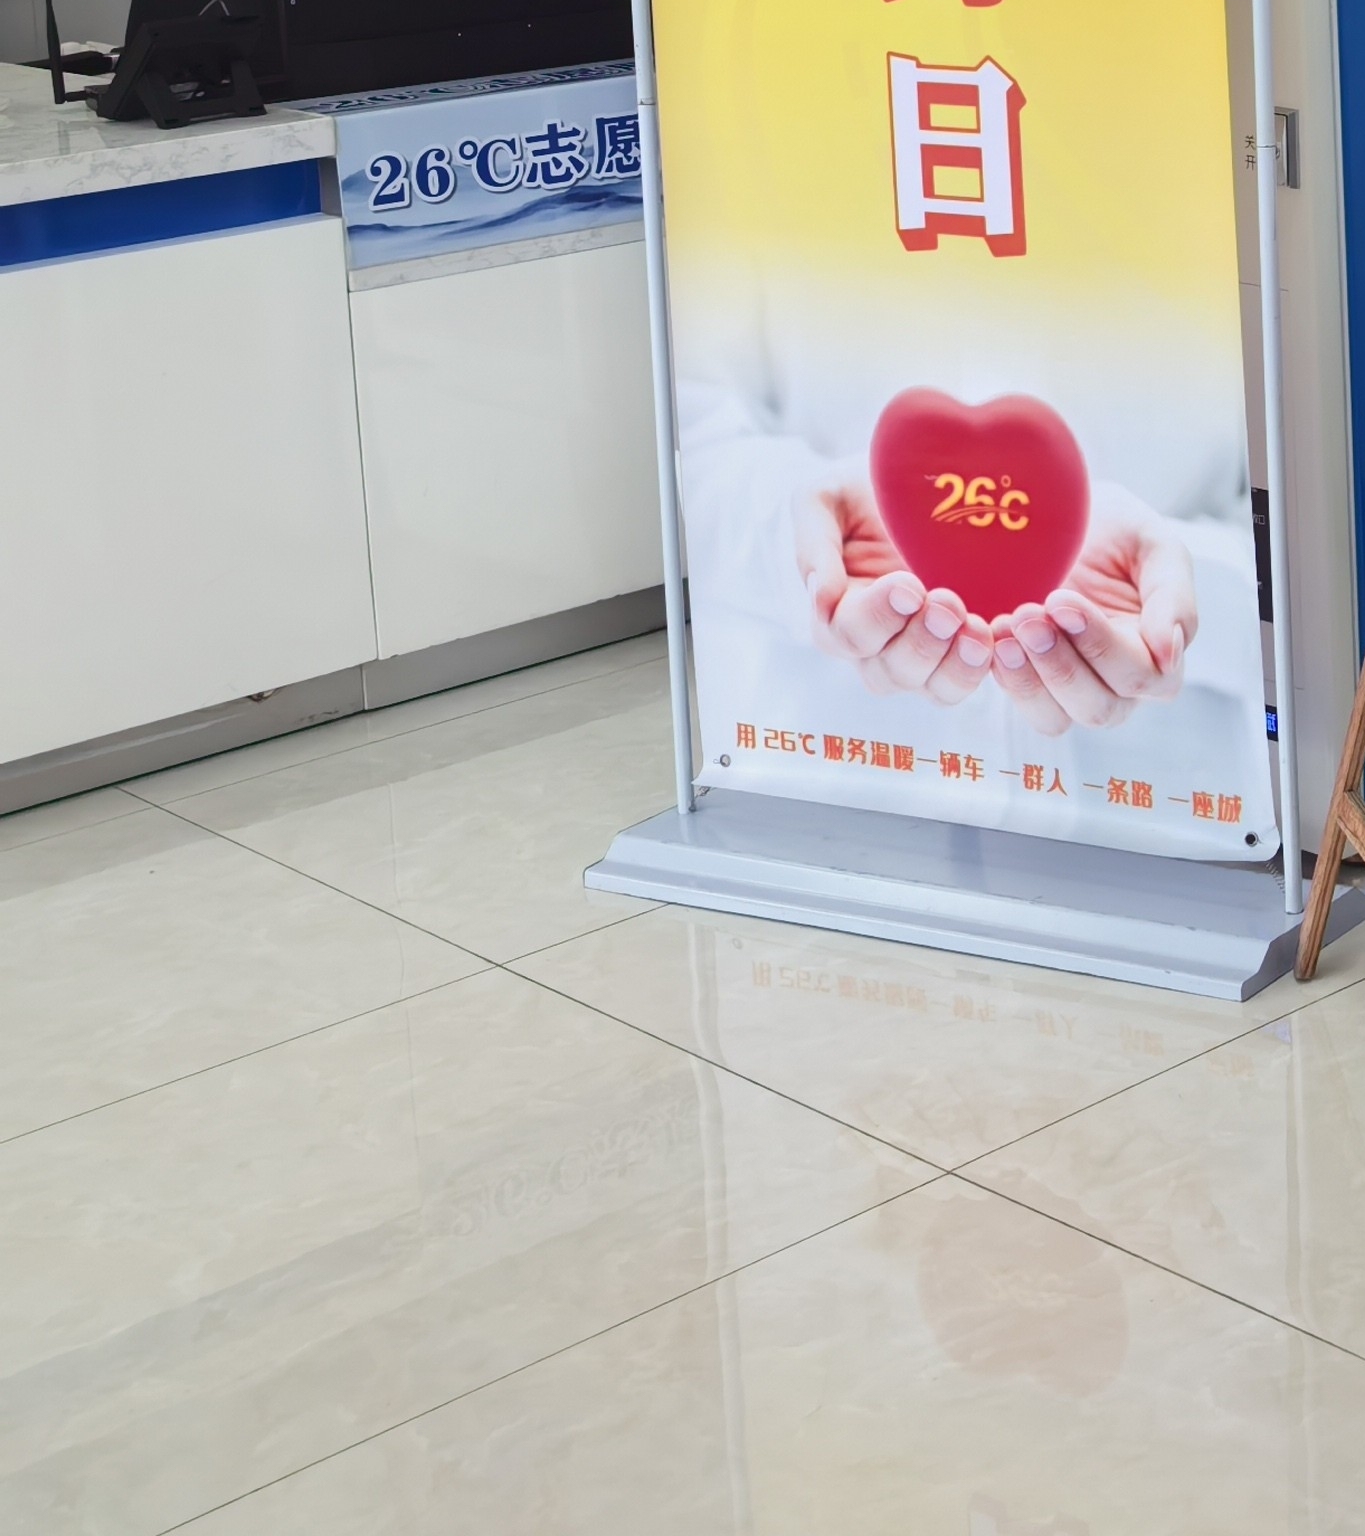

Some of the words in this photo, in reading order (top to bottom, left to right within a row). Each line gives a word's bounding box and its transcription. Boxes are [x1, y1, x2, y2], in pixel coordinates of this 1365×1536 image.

[736, 721, 756, 750] 用
[822, 733, 985, 782] 服务温暖一辆车
[999, 762, 1068, 797] 一群人
[1083, 775, 1153, 809] 一条路
[1167, 789, 1242, 824] 一座城
